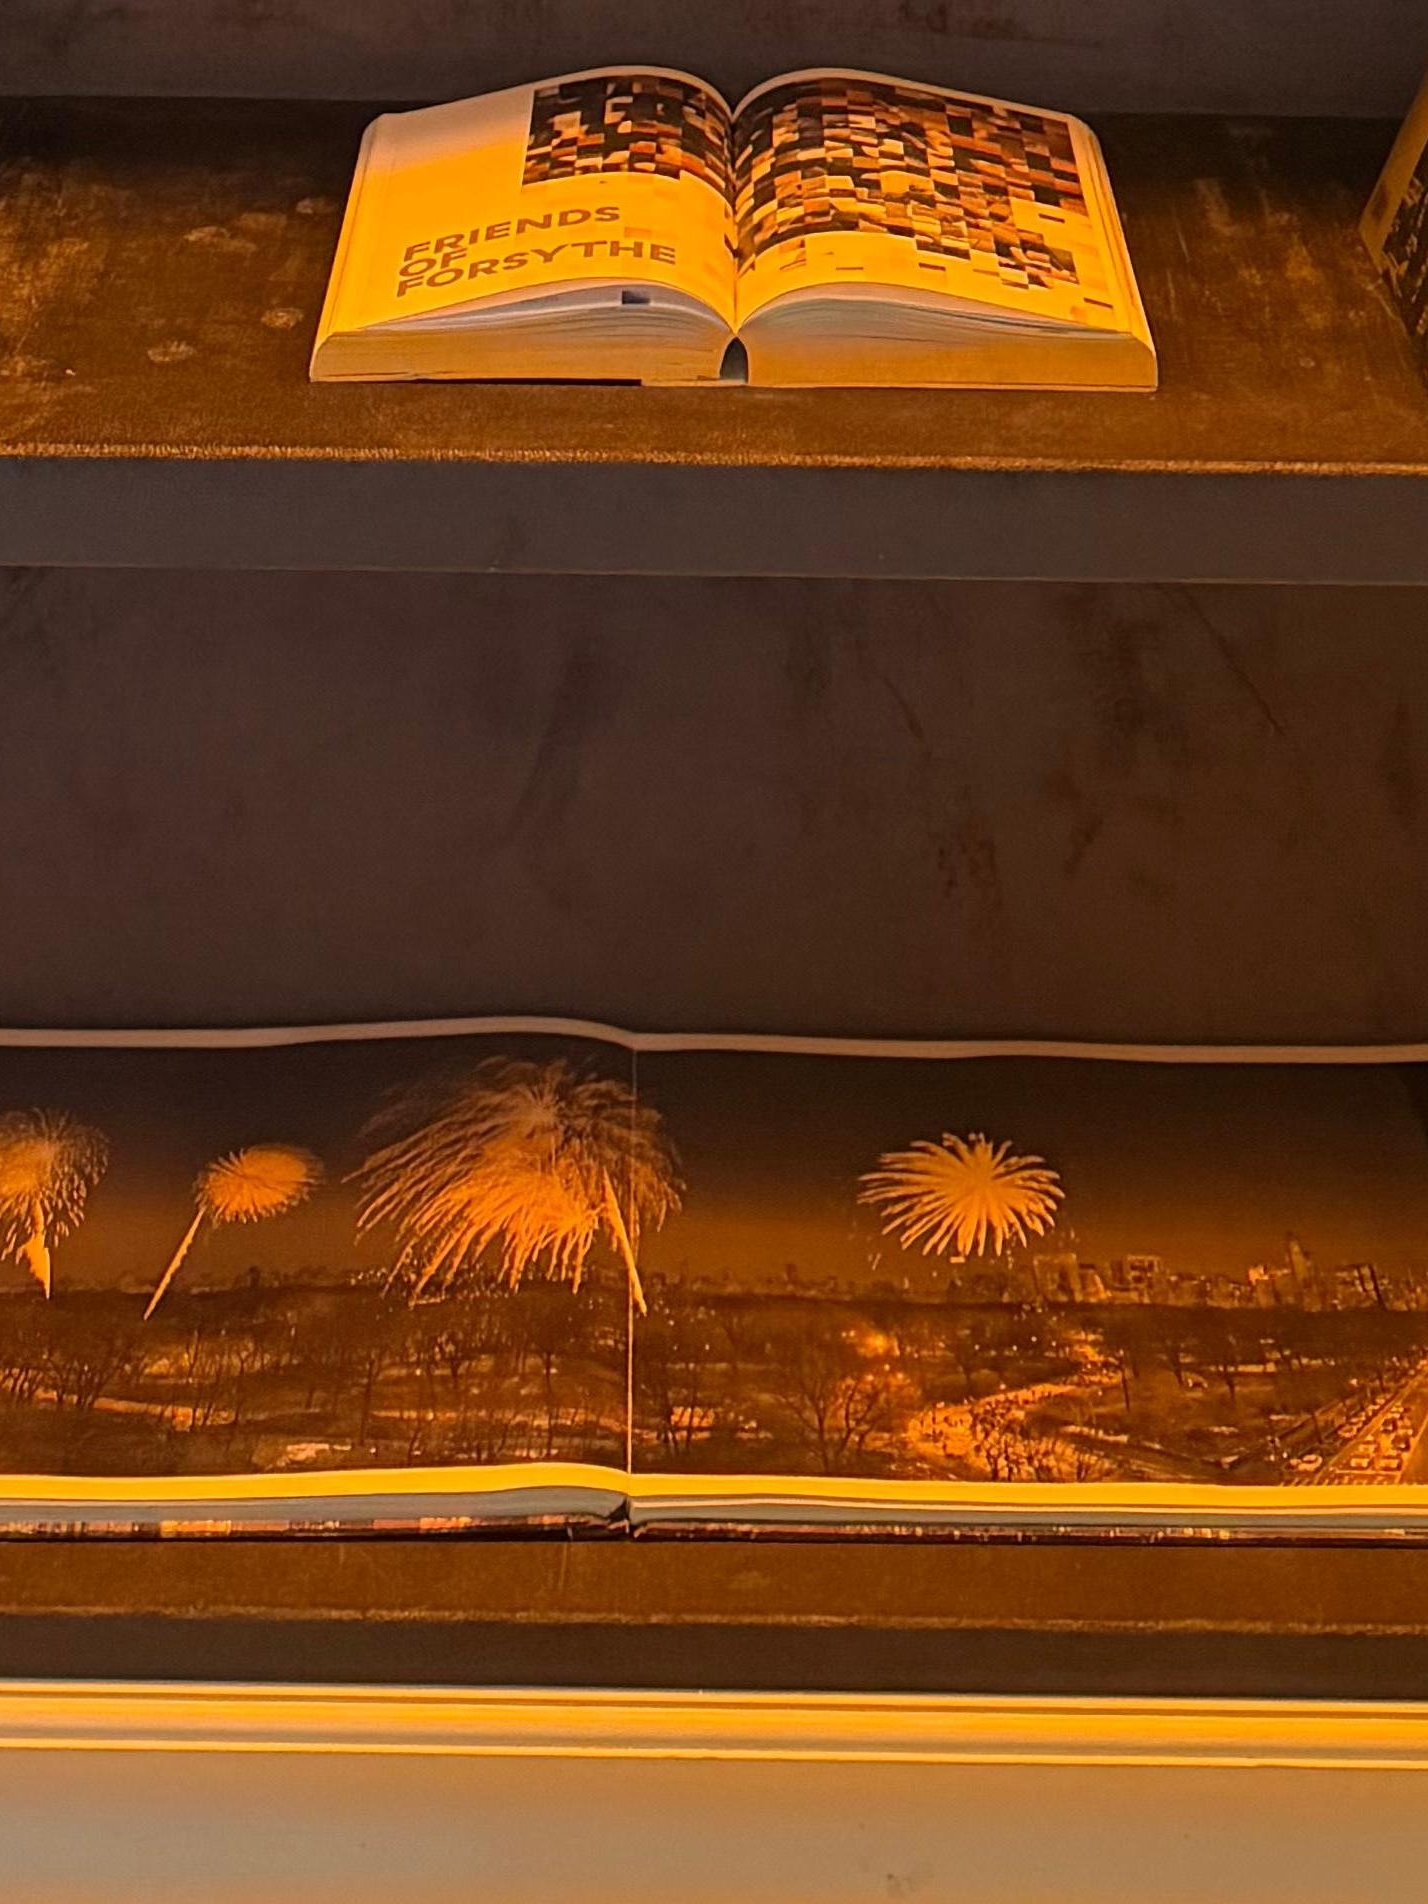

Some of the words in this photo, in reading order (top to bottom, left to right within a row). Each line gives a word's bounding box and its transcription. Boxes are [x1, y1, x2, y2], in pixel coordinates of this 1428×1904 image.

[402, 205, 621, 262] FRIENDS
[396, 240, 677, 298] FORSYTHE
[397, 248, 469, 278] OF
